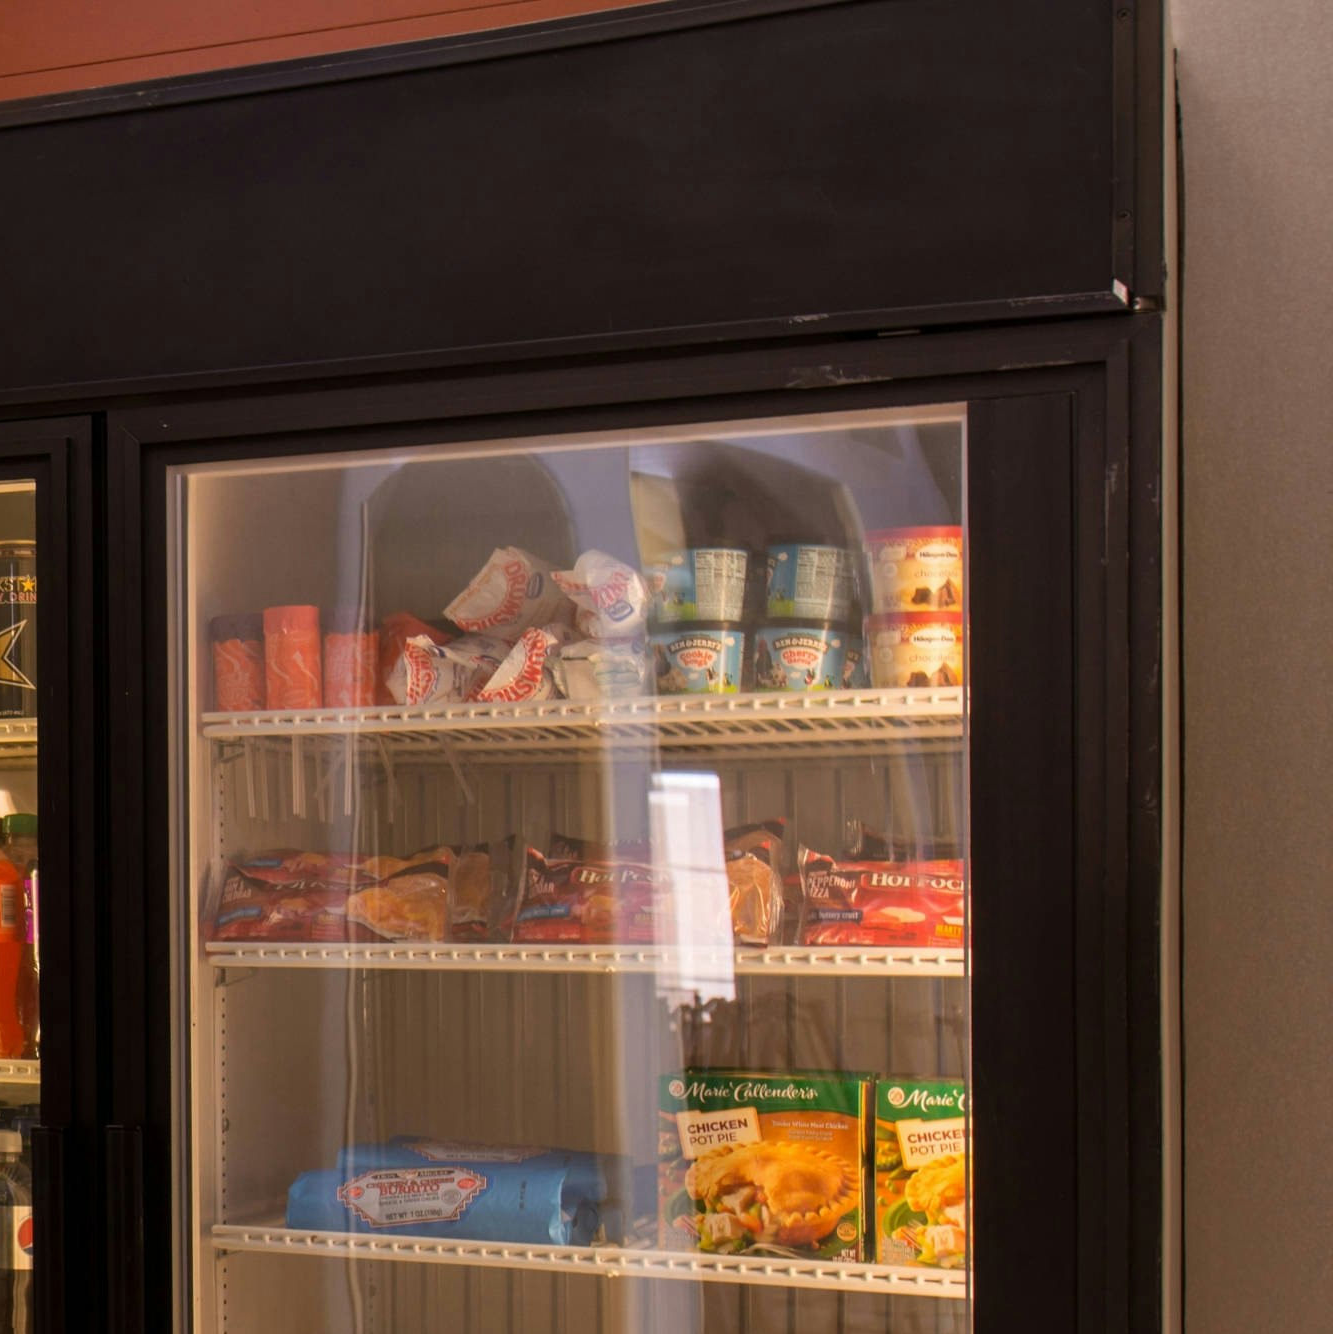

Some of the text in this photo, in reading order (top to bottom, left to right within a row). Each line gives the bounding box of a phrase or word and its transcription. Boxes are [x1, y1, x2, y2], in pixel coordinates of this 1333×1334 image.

[782, 650, 818, 661] Cherry
[871, 872, 911, 888] HOT
[685, 1081, 819, 1103] Marie Callender's
[903, 1088, 955, 1112] Marie
[687, 1118, 748, 1135] CHICKEN
[689, 1132, 738, 1147] POT PIE
[910, 1141, 961, 1156] POT PIE
[379, 1183, 440, 1196] BURRITO
